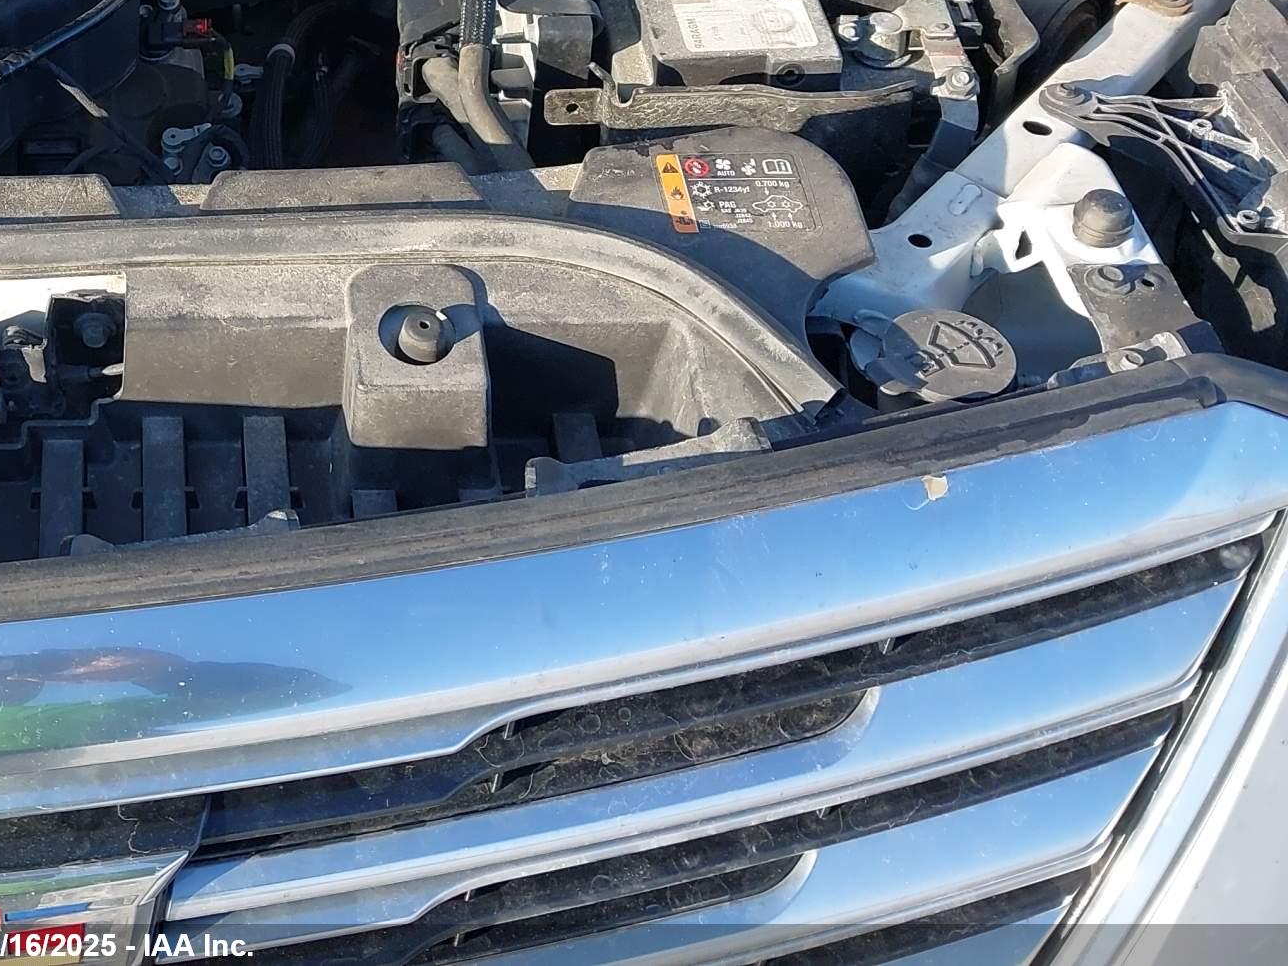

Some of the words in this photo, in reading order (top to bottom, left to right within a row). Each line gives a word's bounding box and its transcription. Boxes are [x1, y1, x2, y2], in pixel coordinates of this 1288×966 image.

[778, 180, 790, 189] kg
[713, 185, 750, 194] R-1234yf
[718, 200, 737, 208] PAG
[767, 220, 791, 228] 1.000
[791, 221, 803, 229] kg
